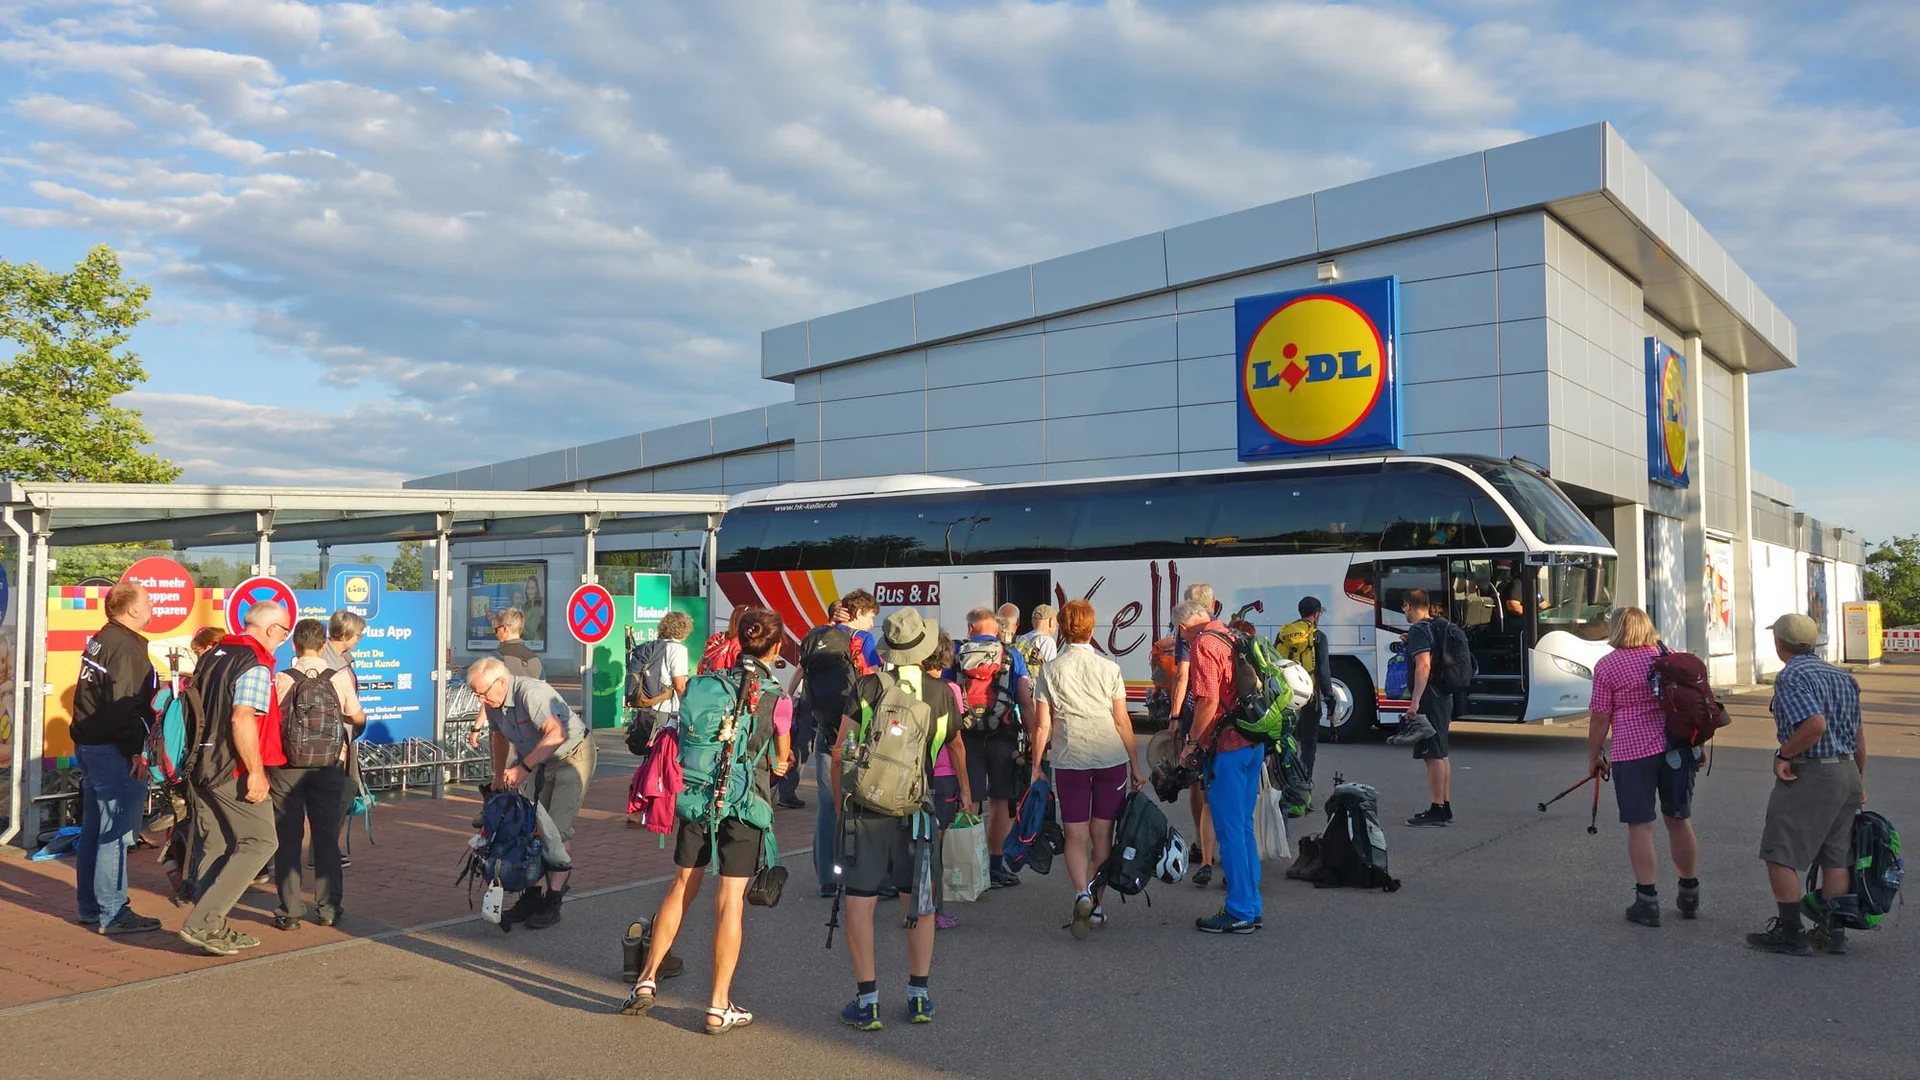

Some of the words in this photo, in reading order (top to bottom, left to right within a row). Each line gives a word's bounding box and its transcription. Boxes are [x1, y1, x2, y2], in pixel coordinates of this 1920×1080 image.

[774, 501, 838, 512] www.hk-keller.de
[158, 578, 187, 588] mehr
[876, 585, 904, 603] Bus
[909, 584, 922, 602] &
[926, 583, 941, 603] R
[152, 606, 187, 617] sparen
[303, 606, 327, 615] digitale
[387, 626, 412, 640] App
[633, 630, 646, 641] ut.
[372, 649, 384, 658] Du
[355, 660, 374, 669] Plus
[375, 659, 400, 668] Kunde
